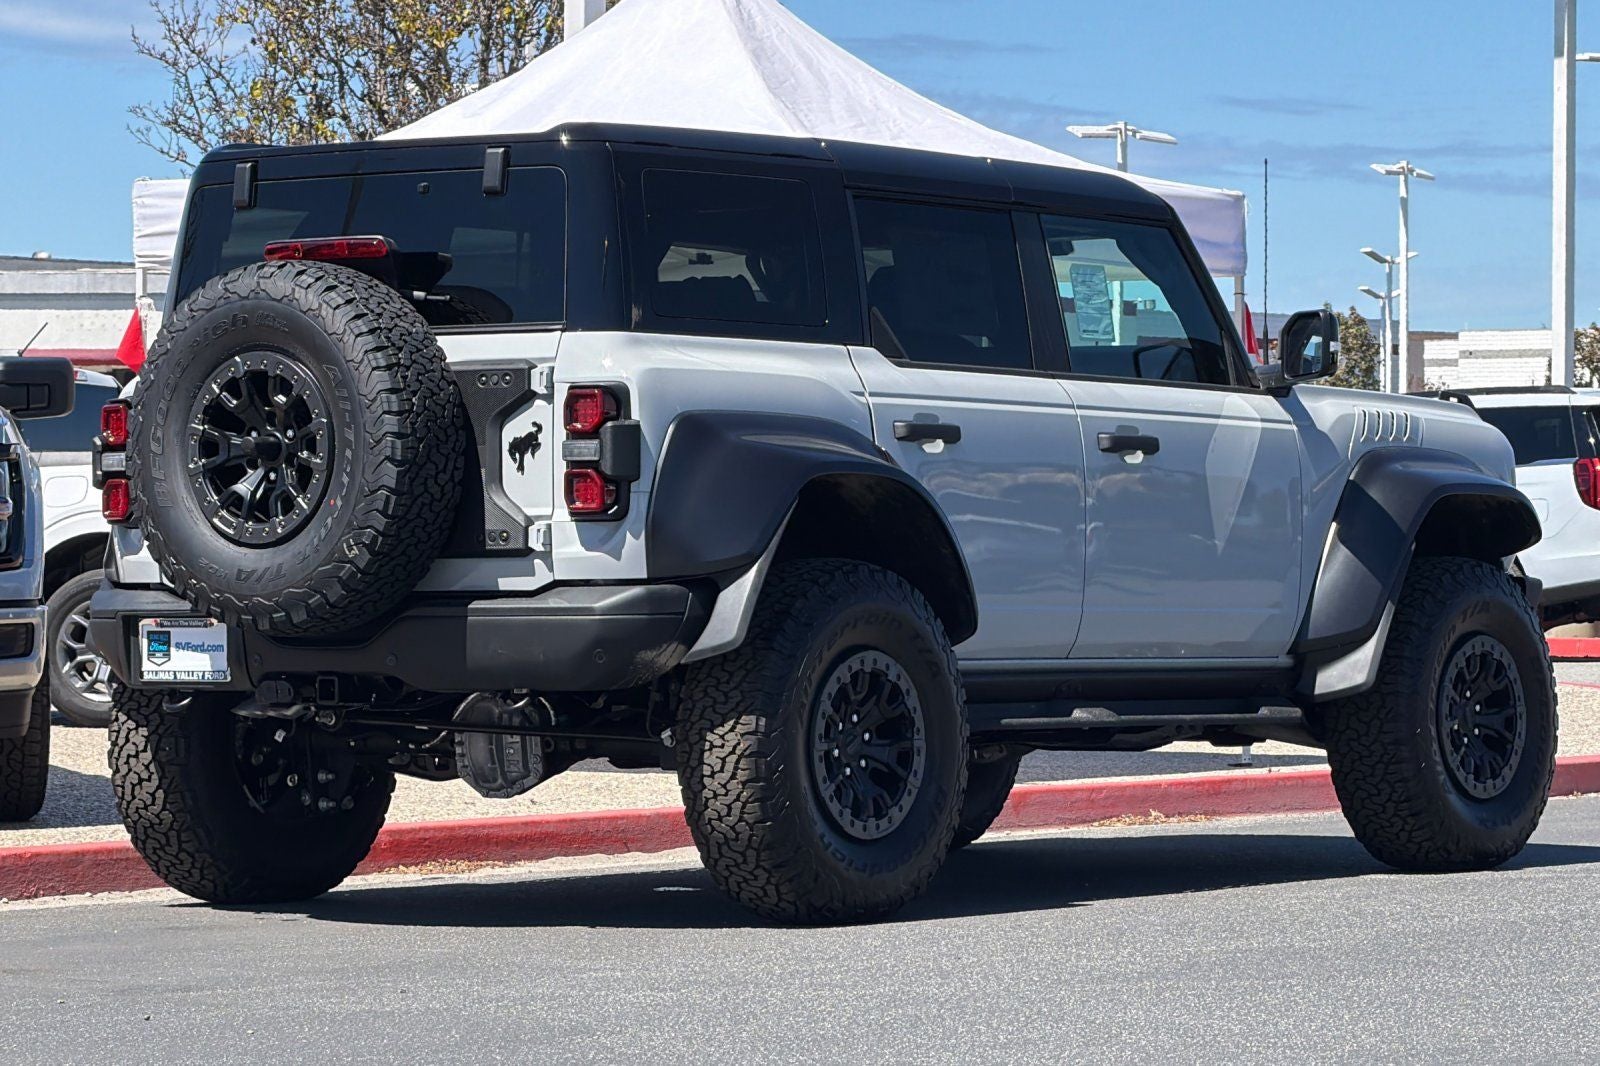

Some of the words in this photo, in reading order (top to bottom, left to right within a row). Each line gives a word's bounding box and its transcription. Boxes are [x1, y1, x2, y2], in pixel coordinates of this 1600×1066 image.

[174, 642, 224, 652] SVFord.com
[143, 671, 174, 680] SALINAS
[176, 671, 203, 680] VALLEY
[204, 671, 224, 680] FORD
